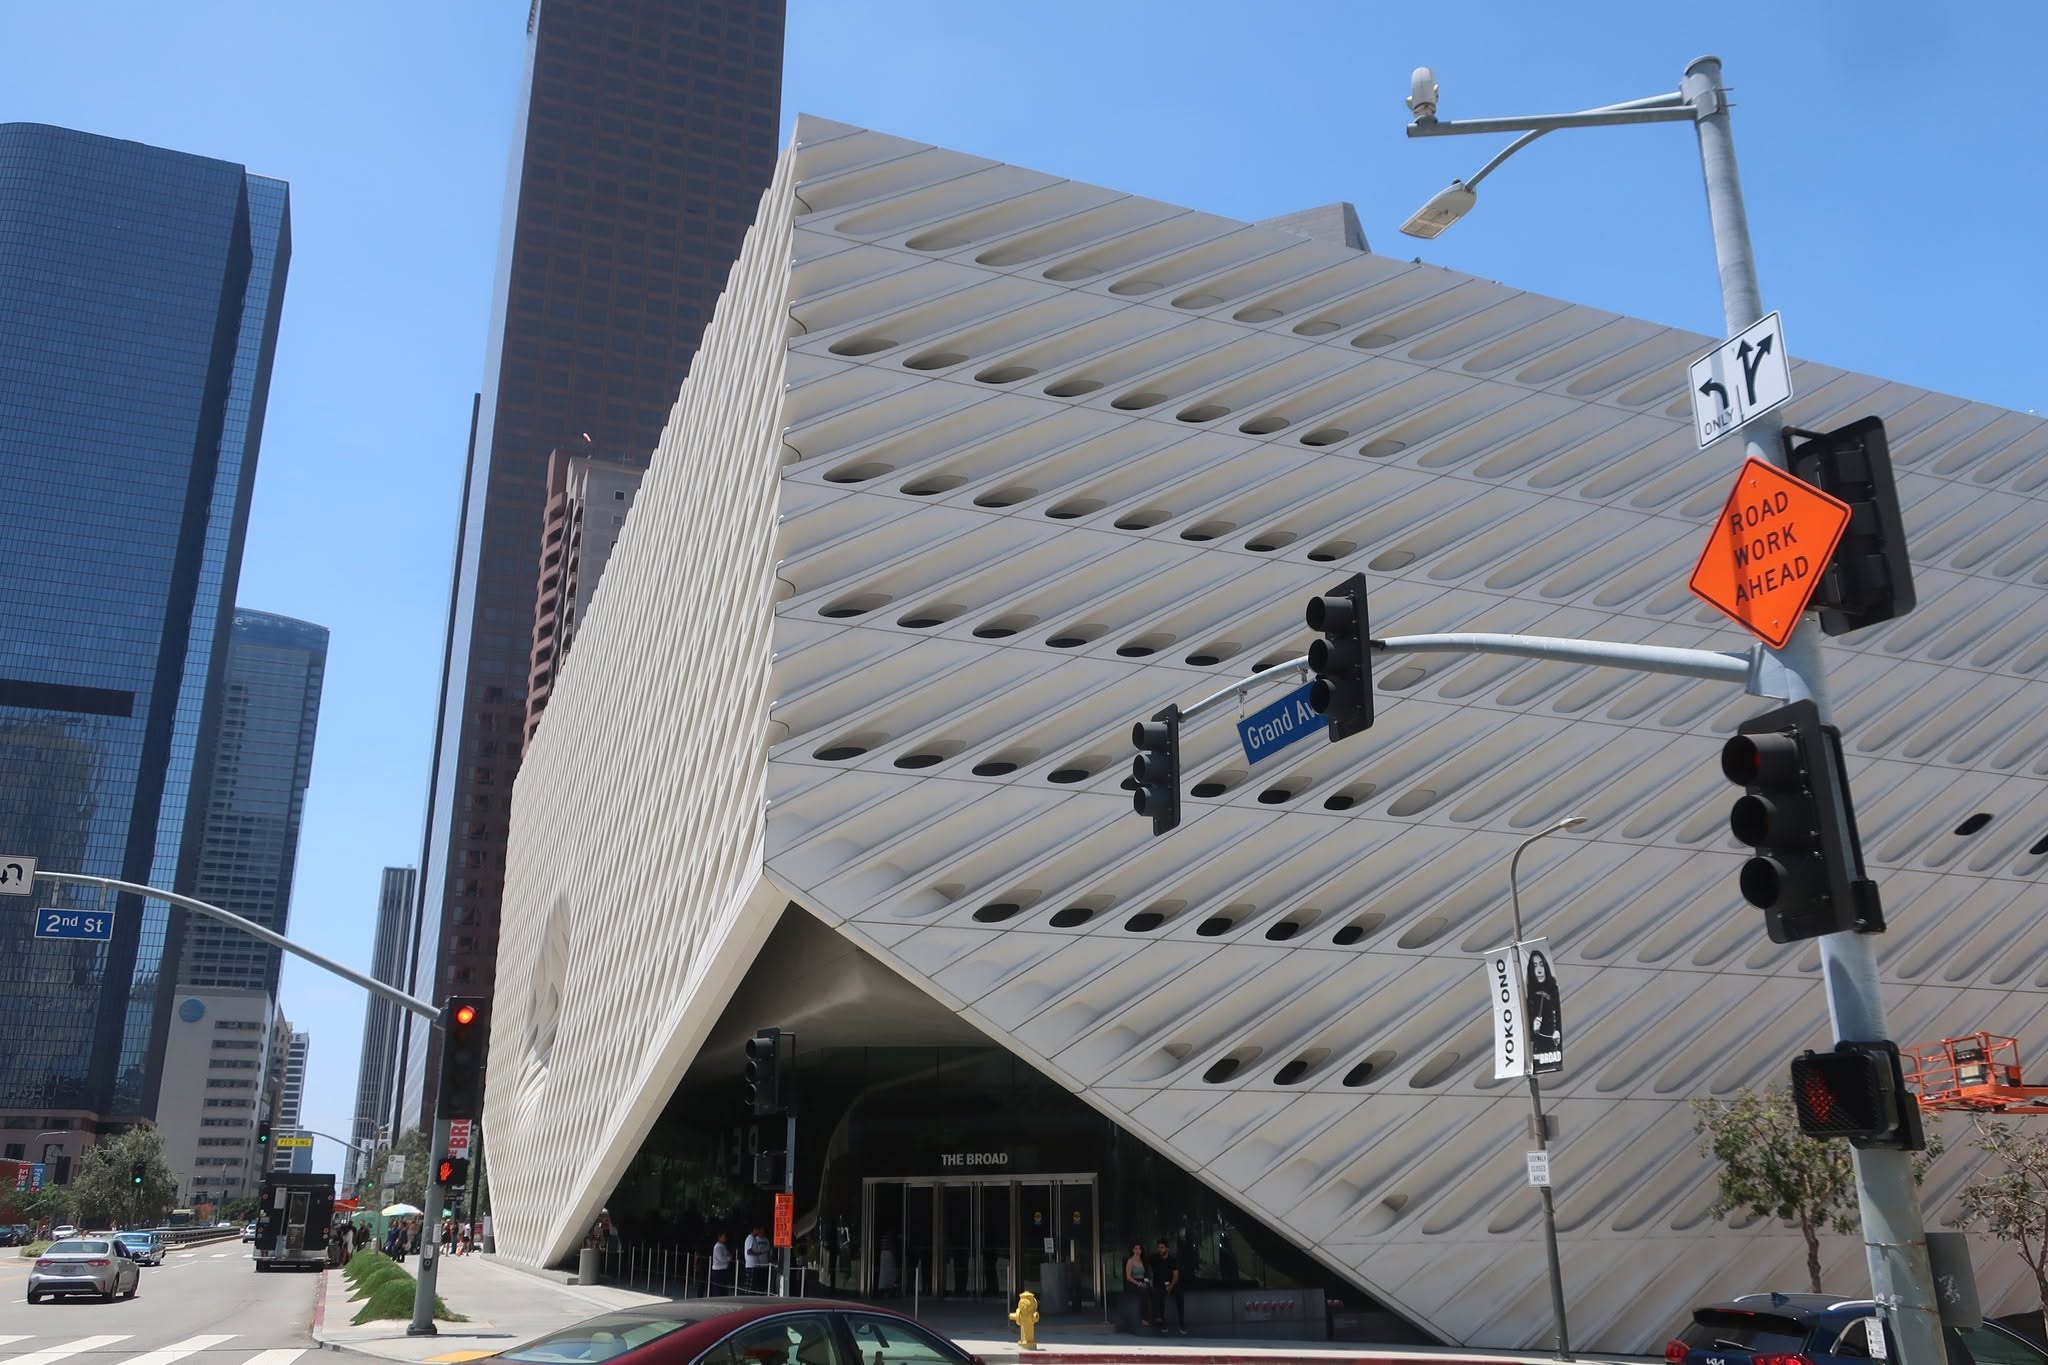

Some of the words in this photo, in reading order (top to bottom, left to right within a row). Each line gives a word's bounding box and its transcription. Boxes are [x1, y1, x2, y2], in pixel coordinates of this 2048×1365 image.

[1704, 407, 1734, 436] ONLY
[1730, 490, 1789, 536] ROAD
[1733, 522, 1798, 570] WORK
[1735, 555, 1809, 607] AHEAD
[1247, 706, 1294, 750] Grand
[1296, 699, 1320, 725] Av
[45, 914, 79, 933] 2nd
[83, 918, 104, 933] St
[1496, 958, 1511, 1004] ONO
[1503, 1008, 1515, 1069] YOKO
[1539, 1050, 1562, 1065] BROAD
[941, 1153, 965, 1166] THE
[966, 1152, 1009, 1166] BROAD
